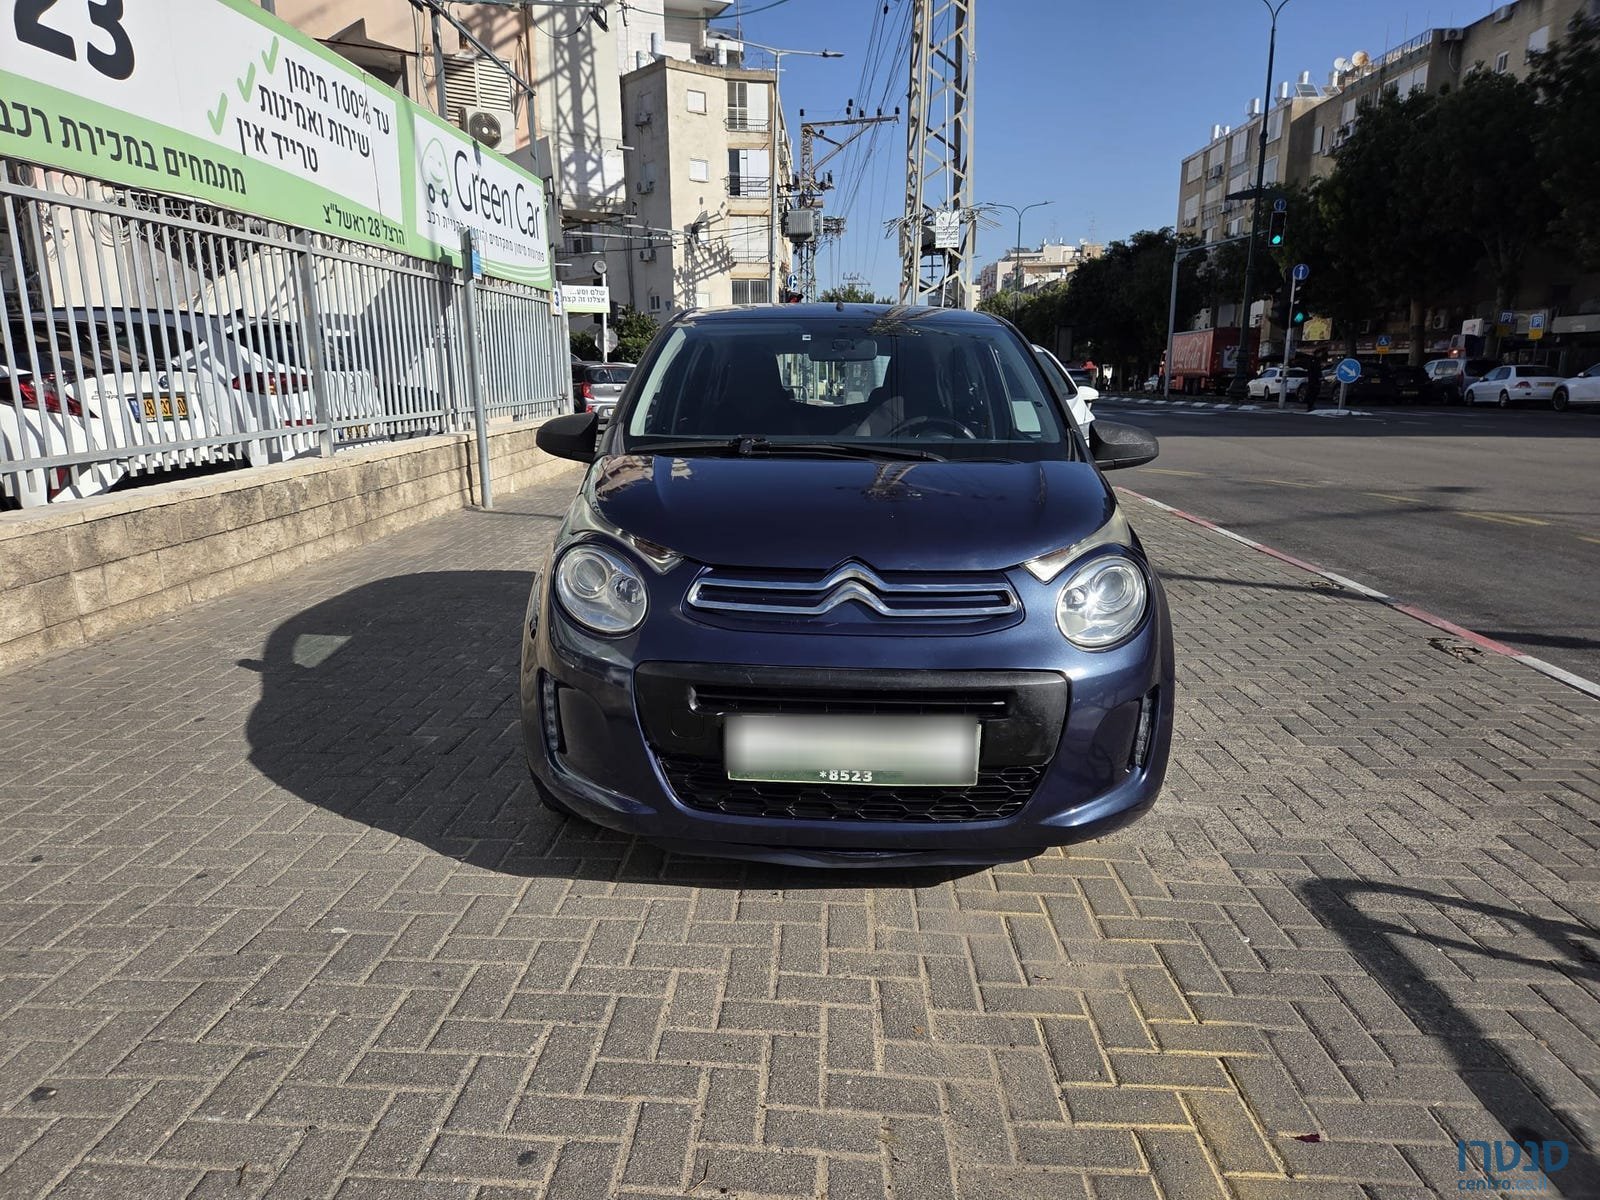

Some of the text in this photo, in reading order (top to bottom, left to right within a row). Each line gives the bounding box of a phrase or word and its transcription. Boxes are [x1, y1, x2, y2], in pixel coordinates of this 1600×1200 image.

[258, 84, 370, 158] שירות ואמינות
[285, 57, 390, 135] עד 100% מימון
[0, 98, 246, 195] מתמחים במכירת רכב
[236, 117, 319, 172] טרייד אין
[367, 216, 381, 238] 28
[426, 210, 441, 226] רכב
[454, 150, 540, 240] Green Car
[382, 219, 405, 245] הרצל
